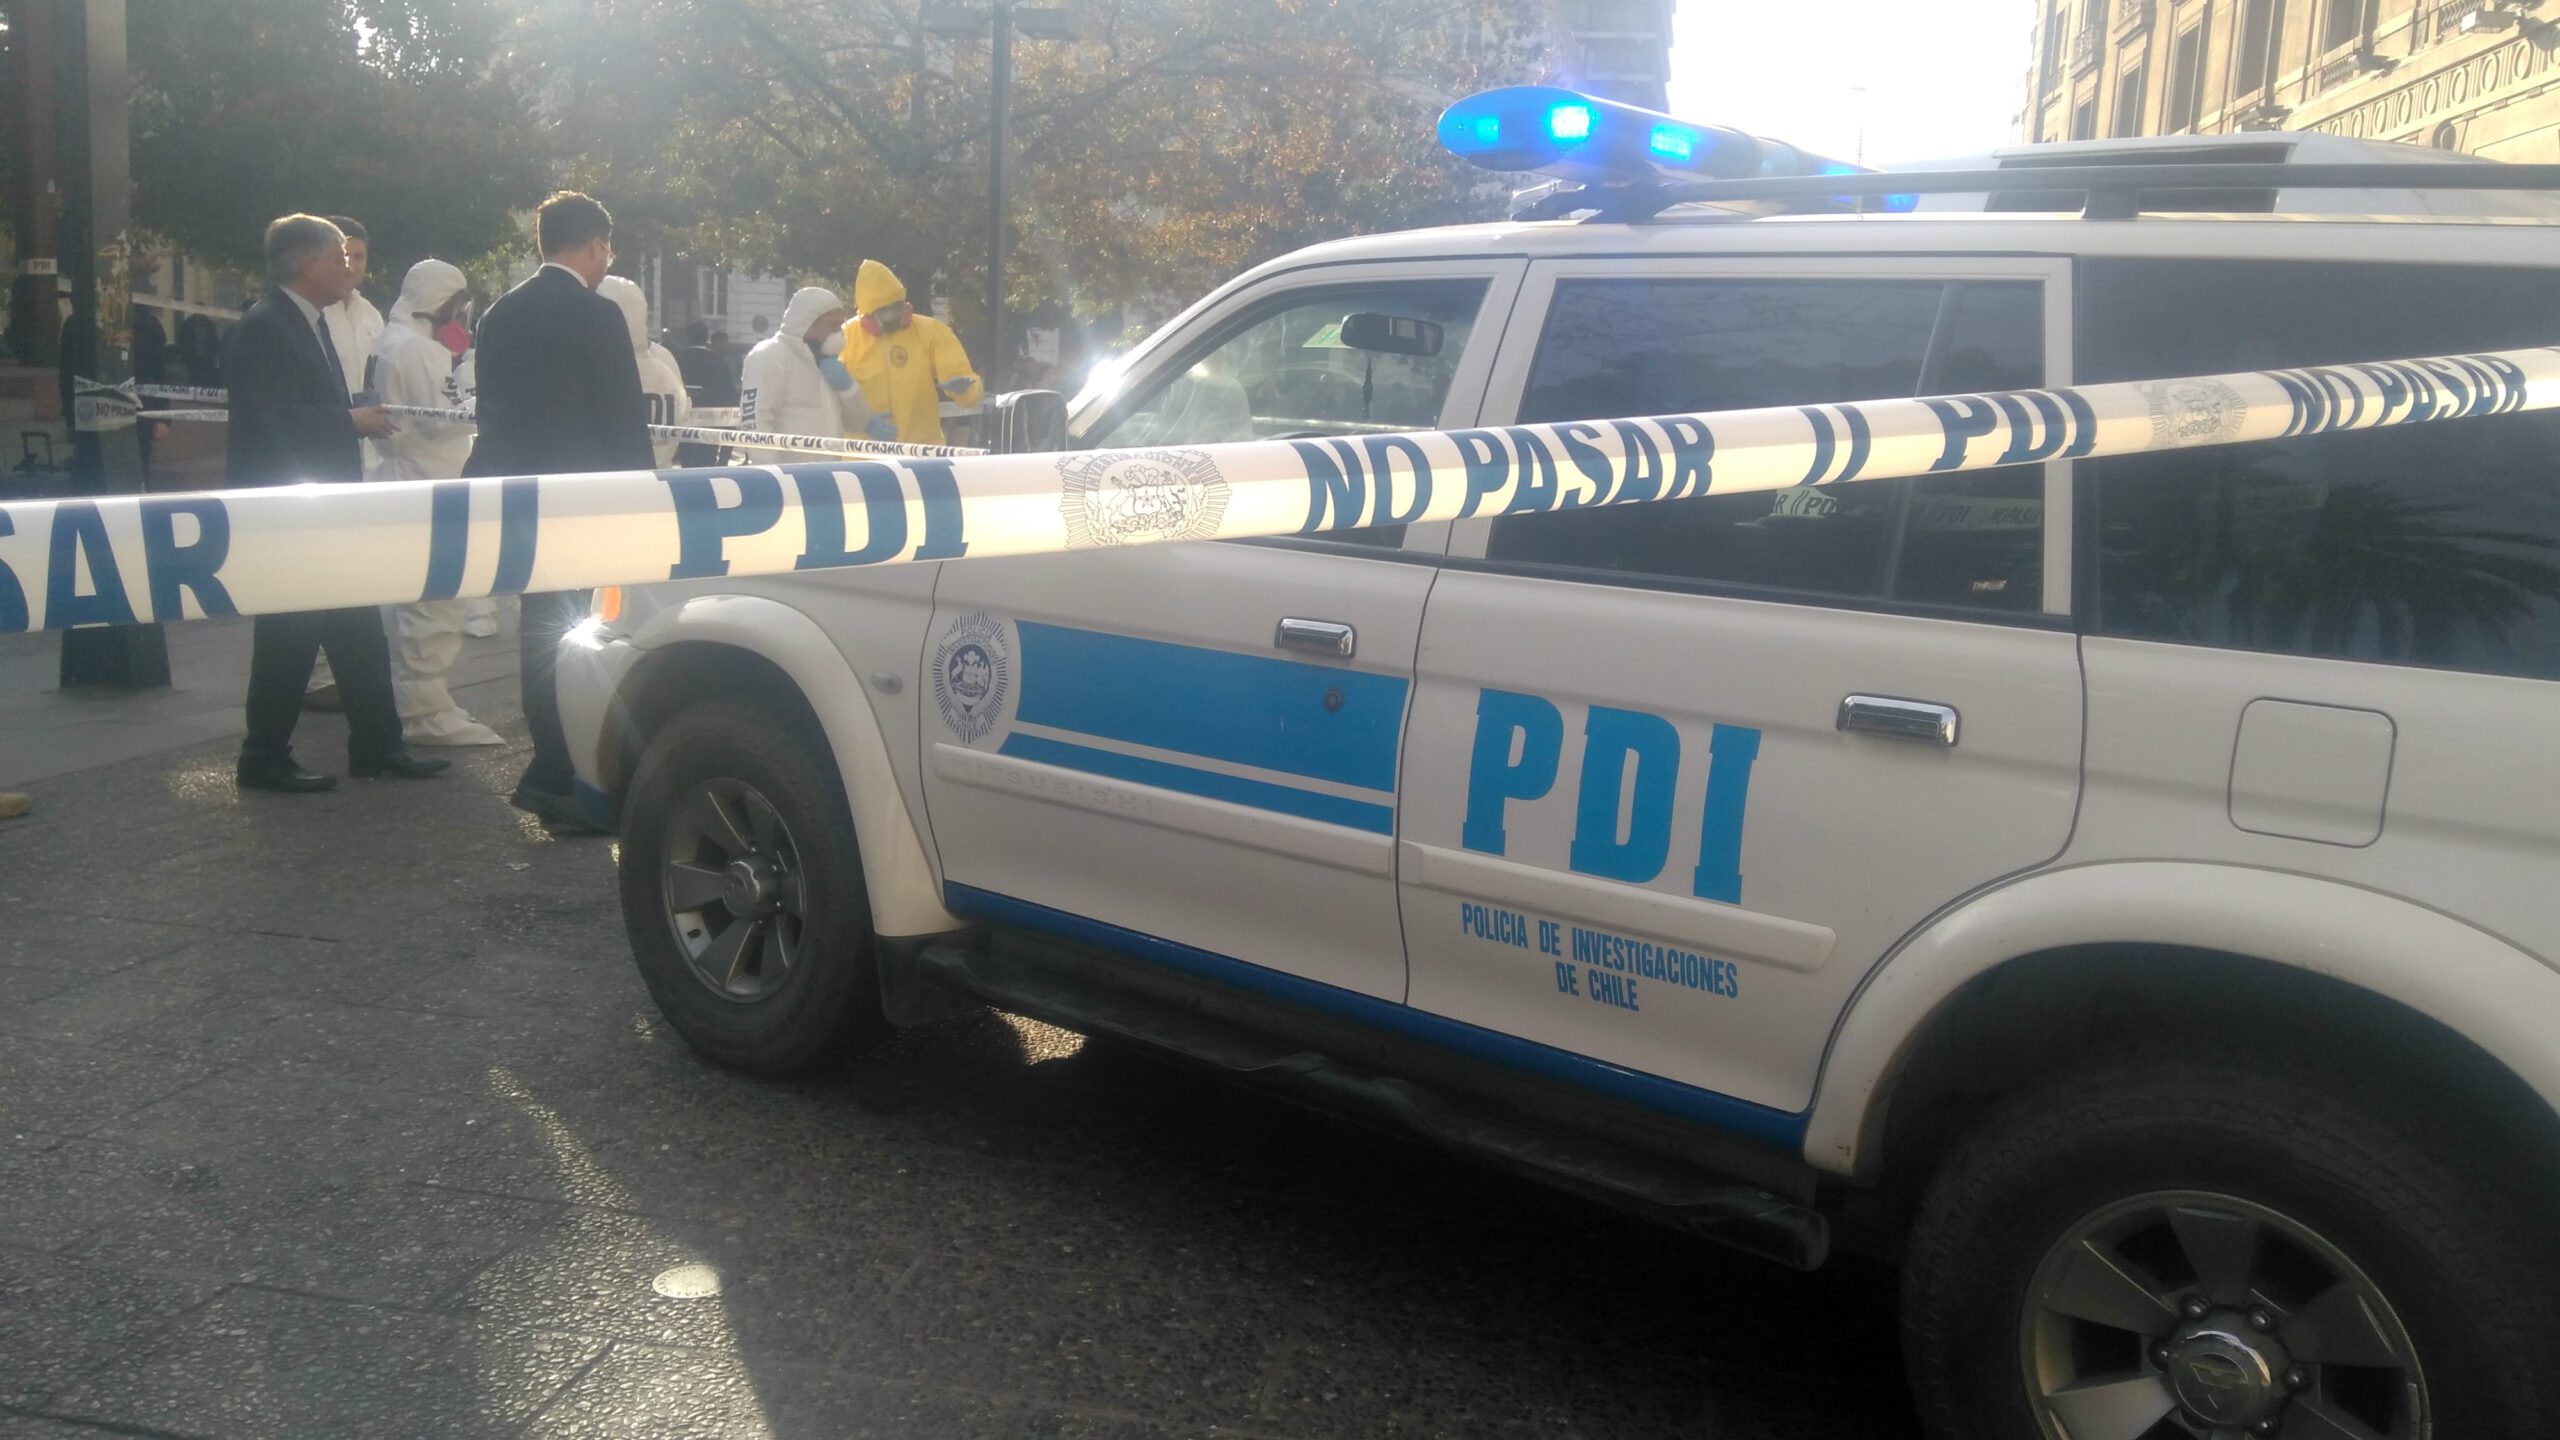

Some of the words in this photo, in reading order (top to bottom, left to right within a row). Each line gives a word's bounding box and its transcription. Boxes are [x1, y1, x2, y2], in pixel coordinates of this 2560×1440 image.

[742, 387, 758, 422] PDI
[1913, 388, 2097, 471] PDI
[2261, 367, 2364, 437] NO
[2349, 355, 2527, 426] PASAR
[1289, 435, 1433, 532] NO
[1445, 416, 1716, 519] PASAR
[653, 459, 969, 580] PDI
[1462, 687, 1761, 905] PDI
[1461, 902, 1528, 948] POLICIA
[1538, 919, 1561, 956] DE
[1571, 926, 1738, 998] INVESTIGACIONES
[1555, 961, 1580, 996] DE
[1588, 969, 1640, 1011] CHILE
